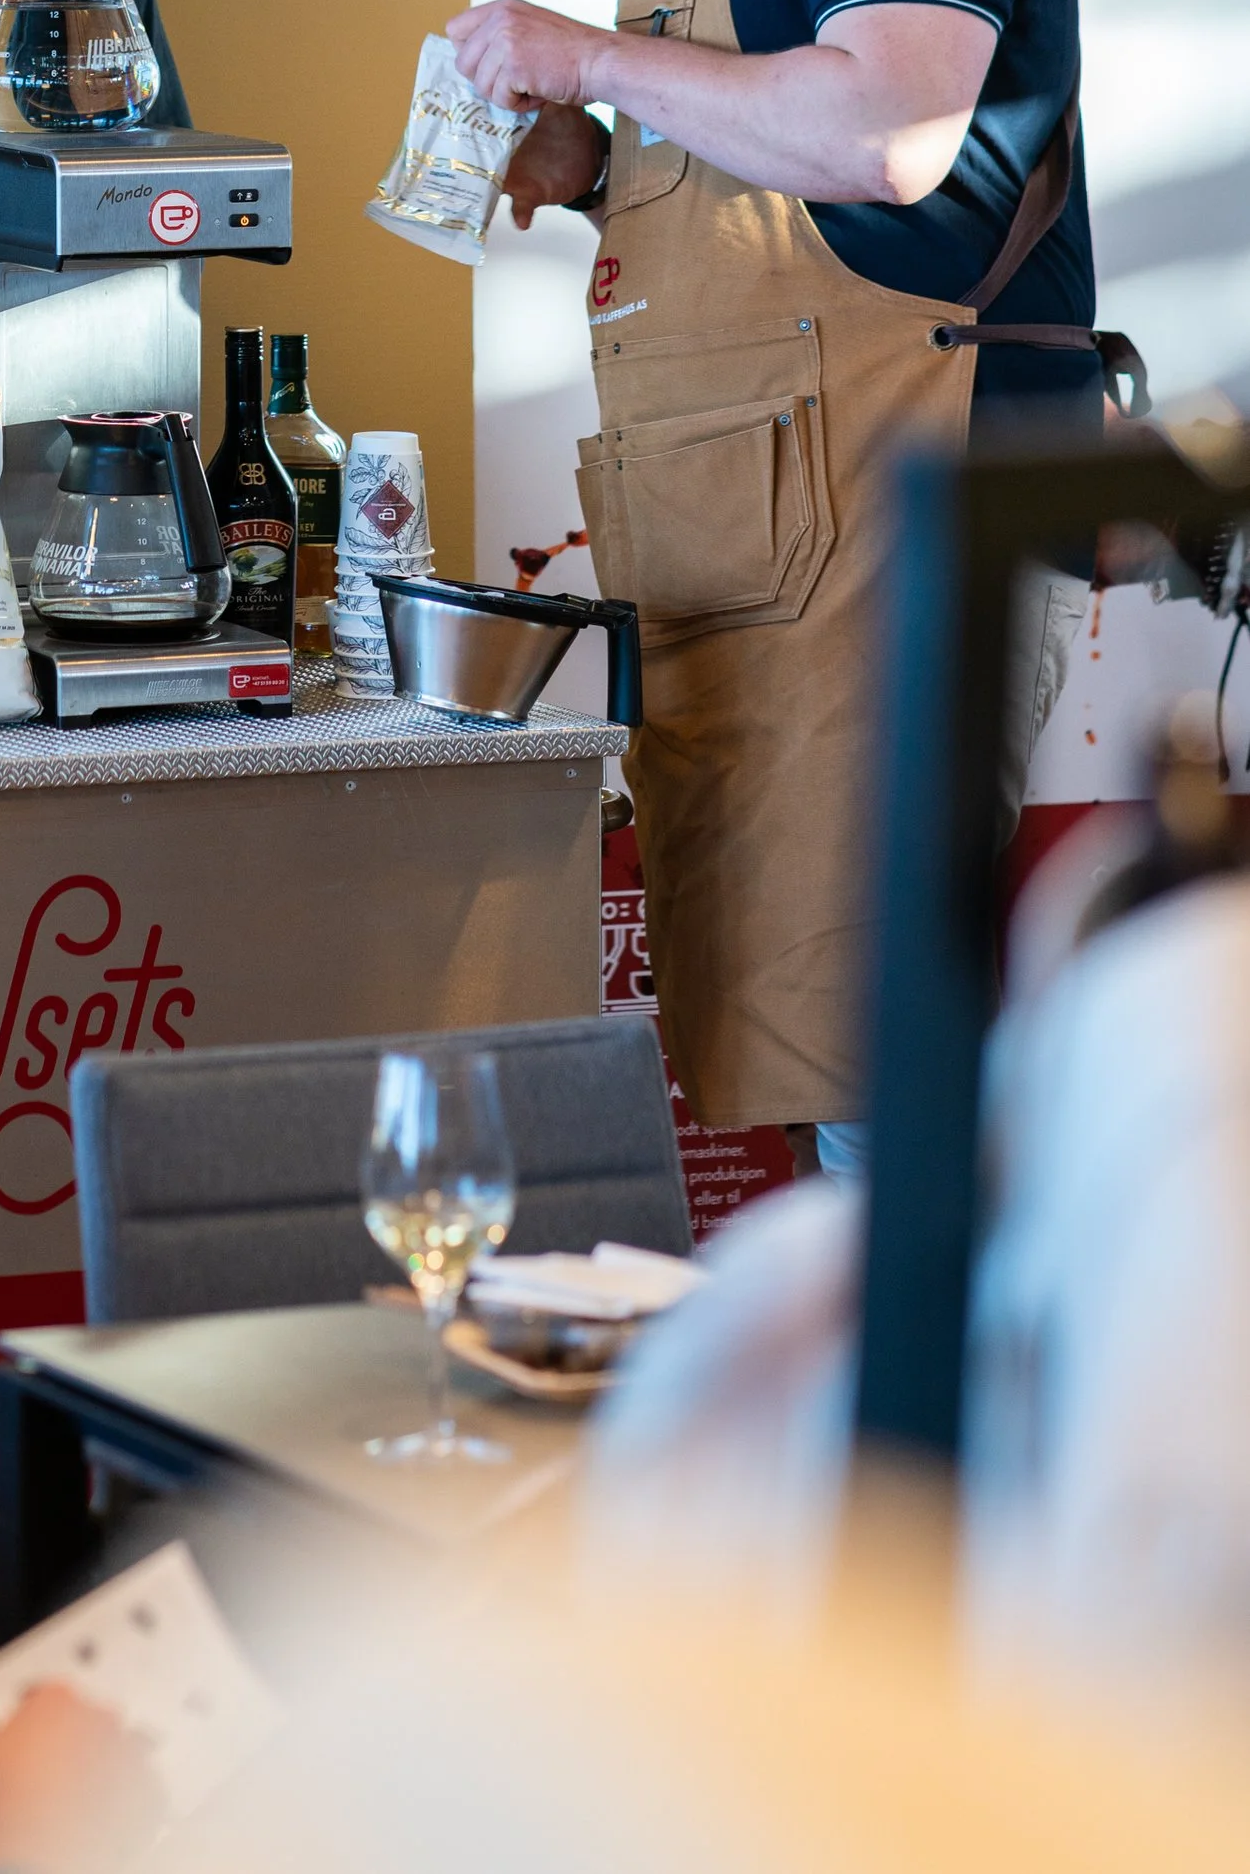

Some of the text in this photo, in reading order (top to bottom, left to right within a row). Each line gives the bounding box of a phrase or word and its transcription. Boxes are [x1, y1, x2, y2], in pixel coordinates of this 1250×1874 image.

[49, 11, 60, 19] 12
[49, 30, 60, 38] 10
[51, 50, 57, 58] 8
[97, 184, 153, 210] Mondo
[137, 518, 148, 526] 12
[220, 524, 291, 544] BAILEYS
[137, 537, 148, 546] 10
[140, 558, 146, 566] 8
[228, 593, 285, 603] ORIGINAL
[689, 1165, 767, 1186] produksjon
[694, 1188, 741, 1206] eller til
